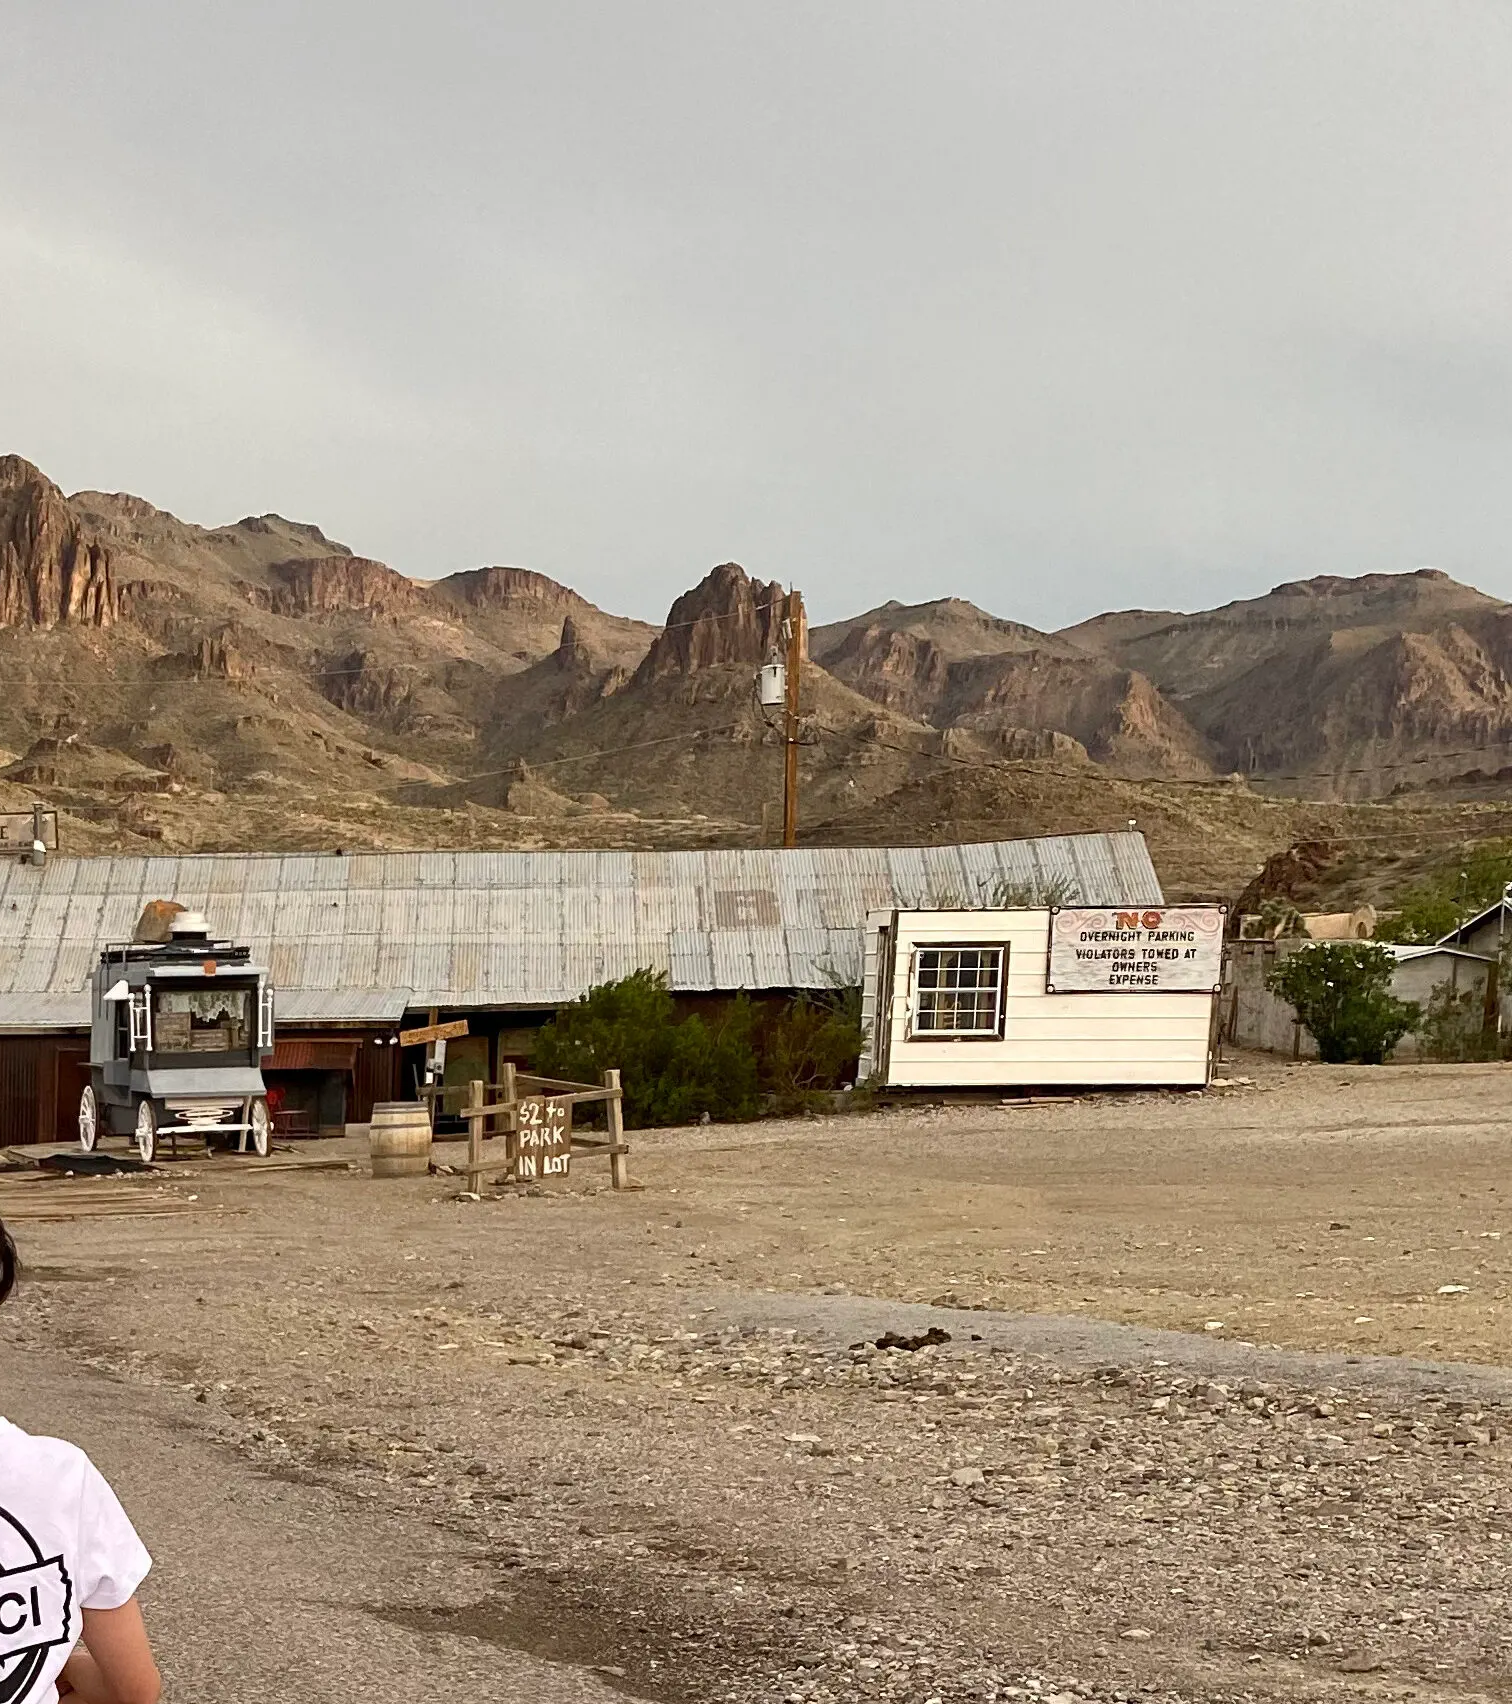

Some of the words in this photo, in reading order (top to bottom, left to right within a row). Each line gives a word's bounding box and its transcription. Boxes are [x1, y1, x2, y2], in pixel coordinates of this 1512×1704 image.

[1115, 911, 1163, 930] NO
[1080, 931, 1142, 942] OVERNIGHT
[1148, 931, 1195, 942] PARKING
[1076, 949, 1135, 960] VIOLATORS
[1142, 949, 1179, 960] TOWED
[1183, 949, 1197, 959] AT
[1111, 962, 1158, 973] OWNERS
[1109, 975, 1159, 986] EXPENSE
[519, 1101, 543, 1125] $2
[546, 1101, 565, 1119] to
[519, 1125, 565, 1149] PARK
[519, 1155, 536, 1176] IN
[543, 1153, 571, 1175] LOT
